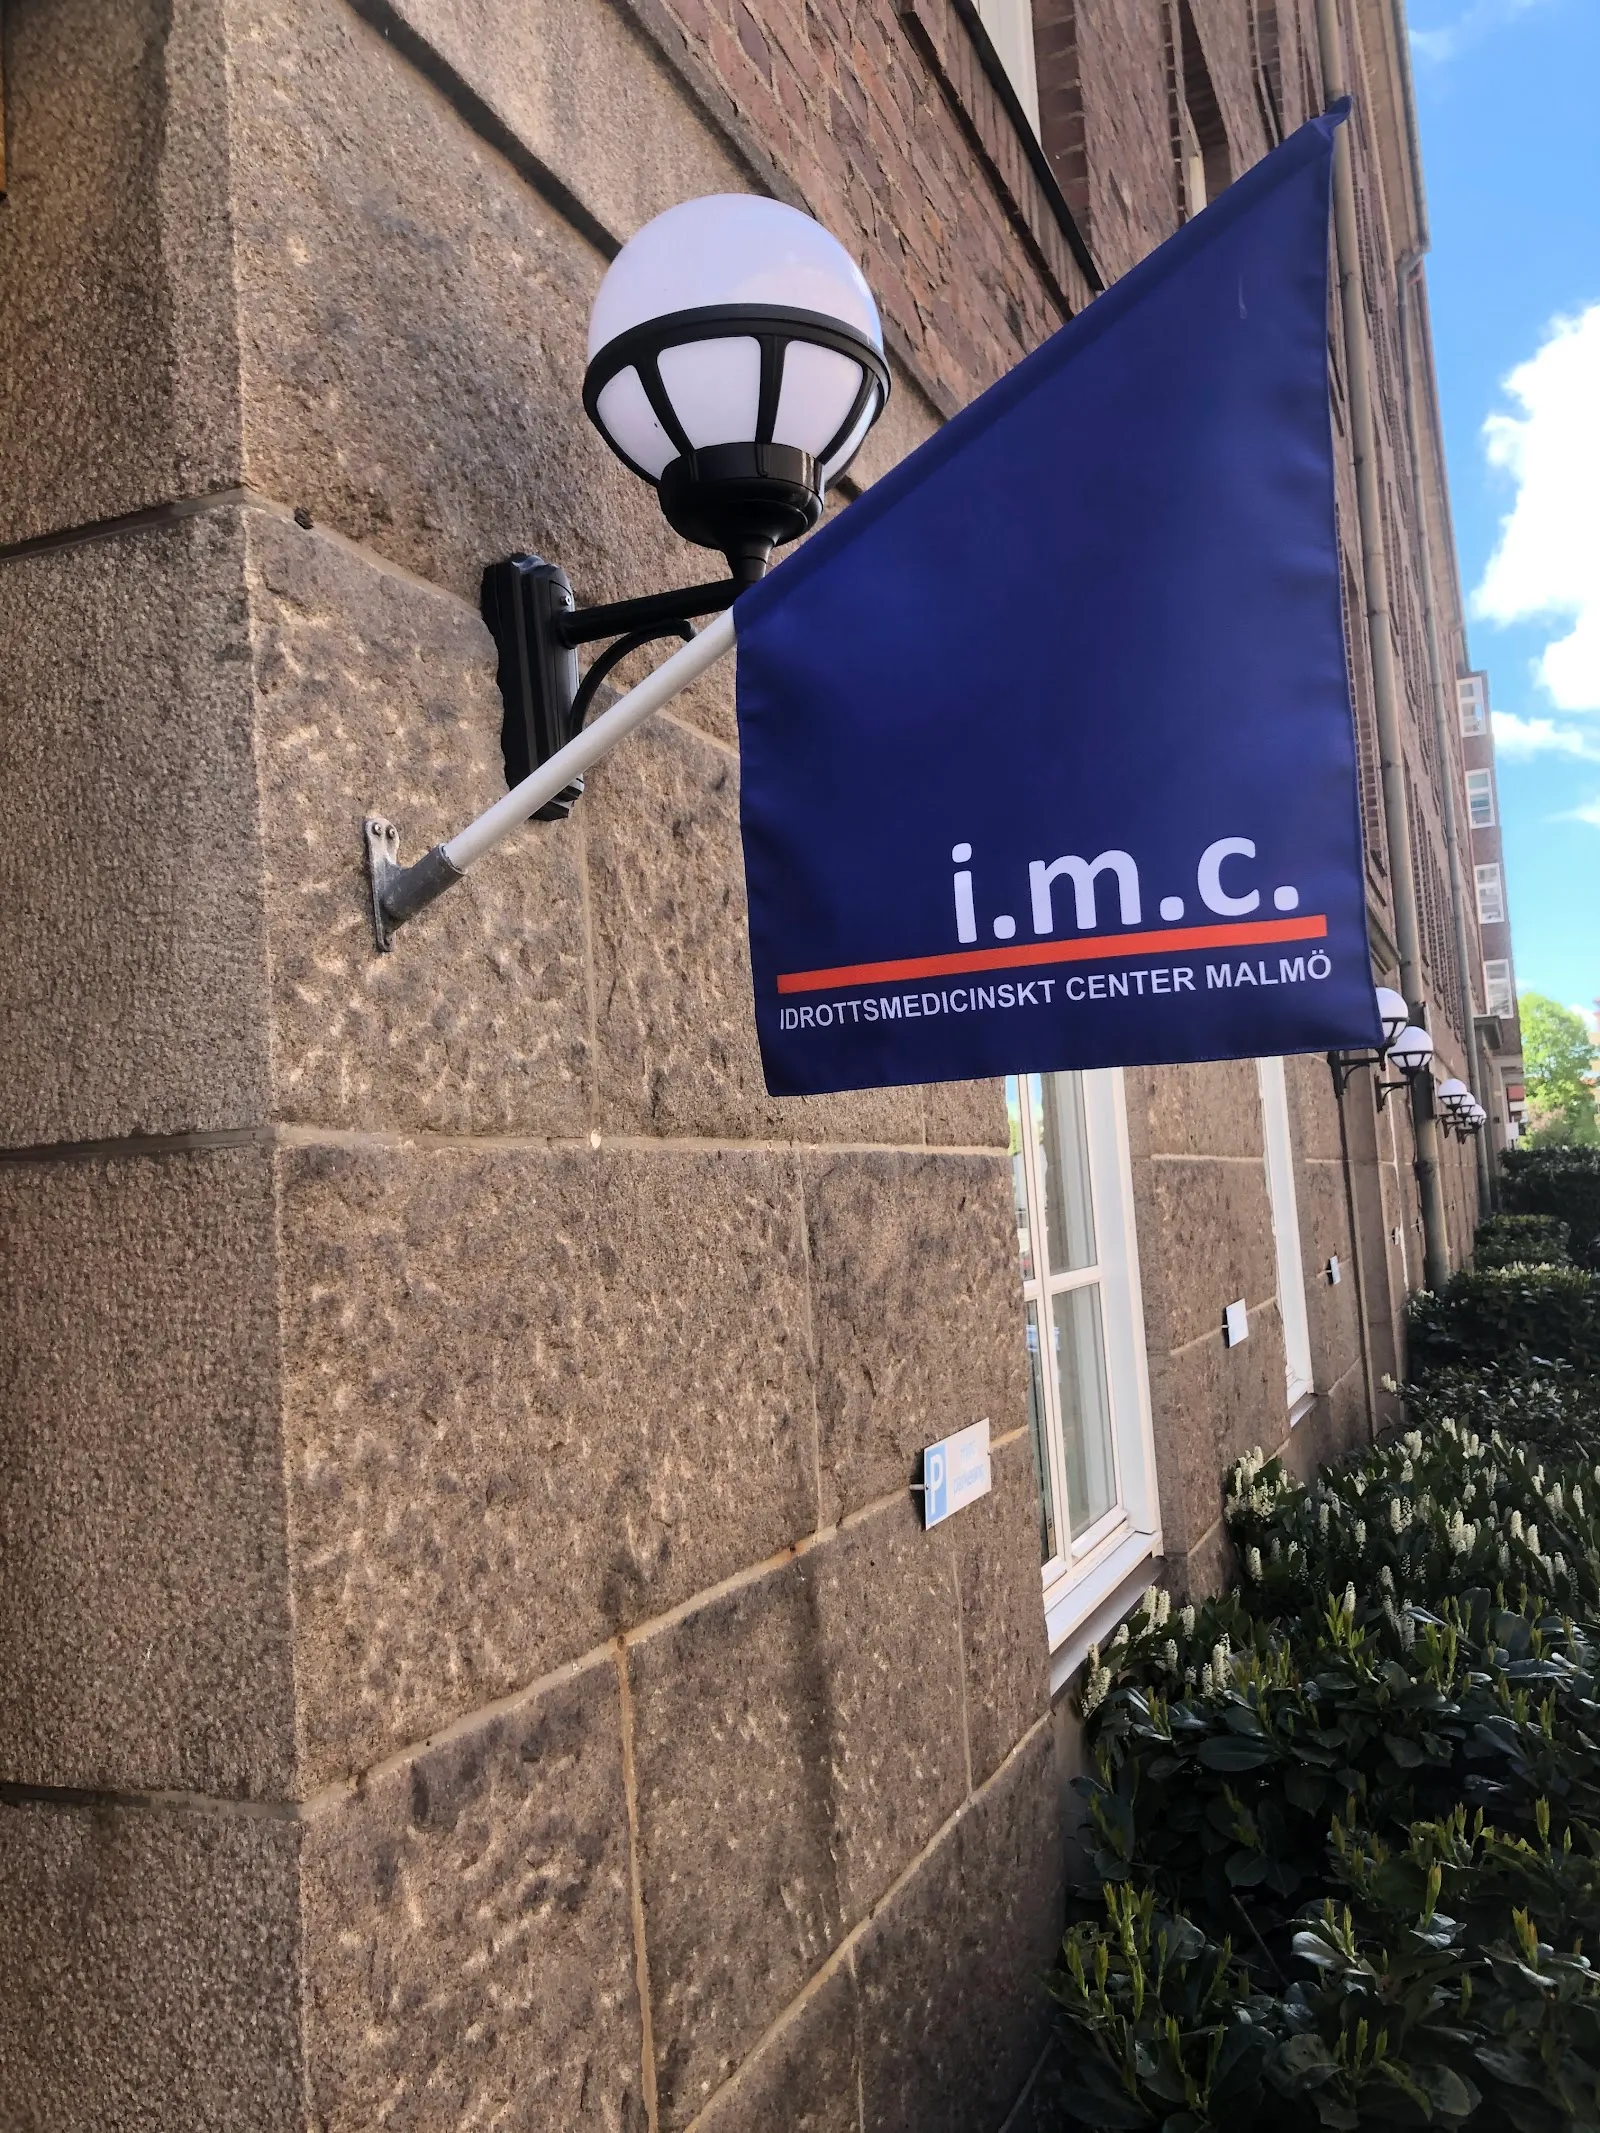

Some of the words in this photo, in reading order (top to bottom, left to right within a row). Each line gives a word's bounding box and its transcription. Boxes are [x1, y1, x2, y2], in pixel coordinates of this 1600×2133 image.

[952, 836, 1299, 944] i.m.c.
[779, 980, 1056, 1031] IDROTTSMEDICINSKT
[1065, 967, 1197, 1004] CENTER
[1206, 949, 1333, 990] MALMÖ
[930, 1454, 944, 1515] P
